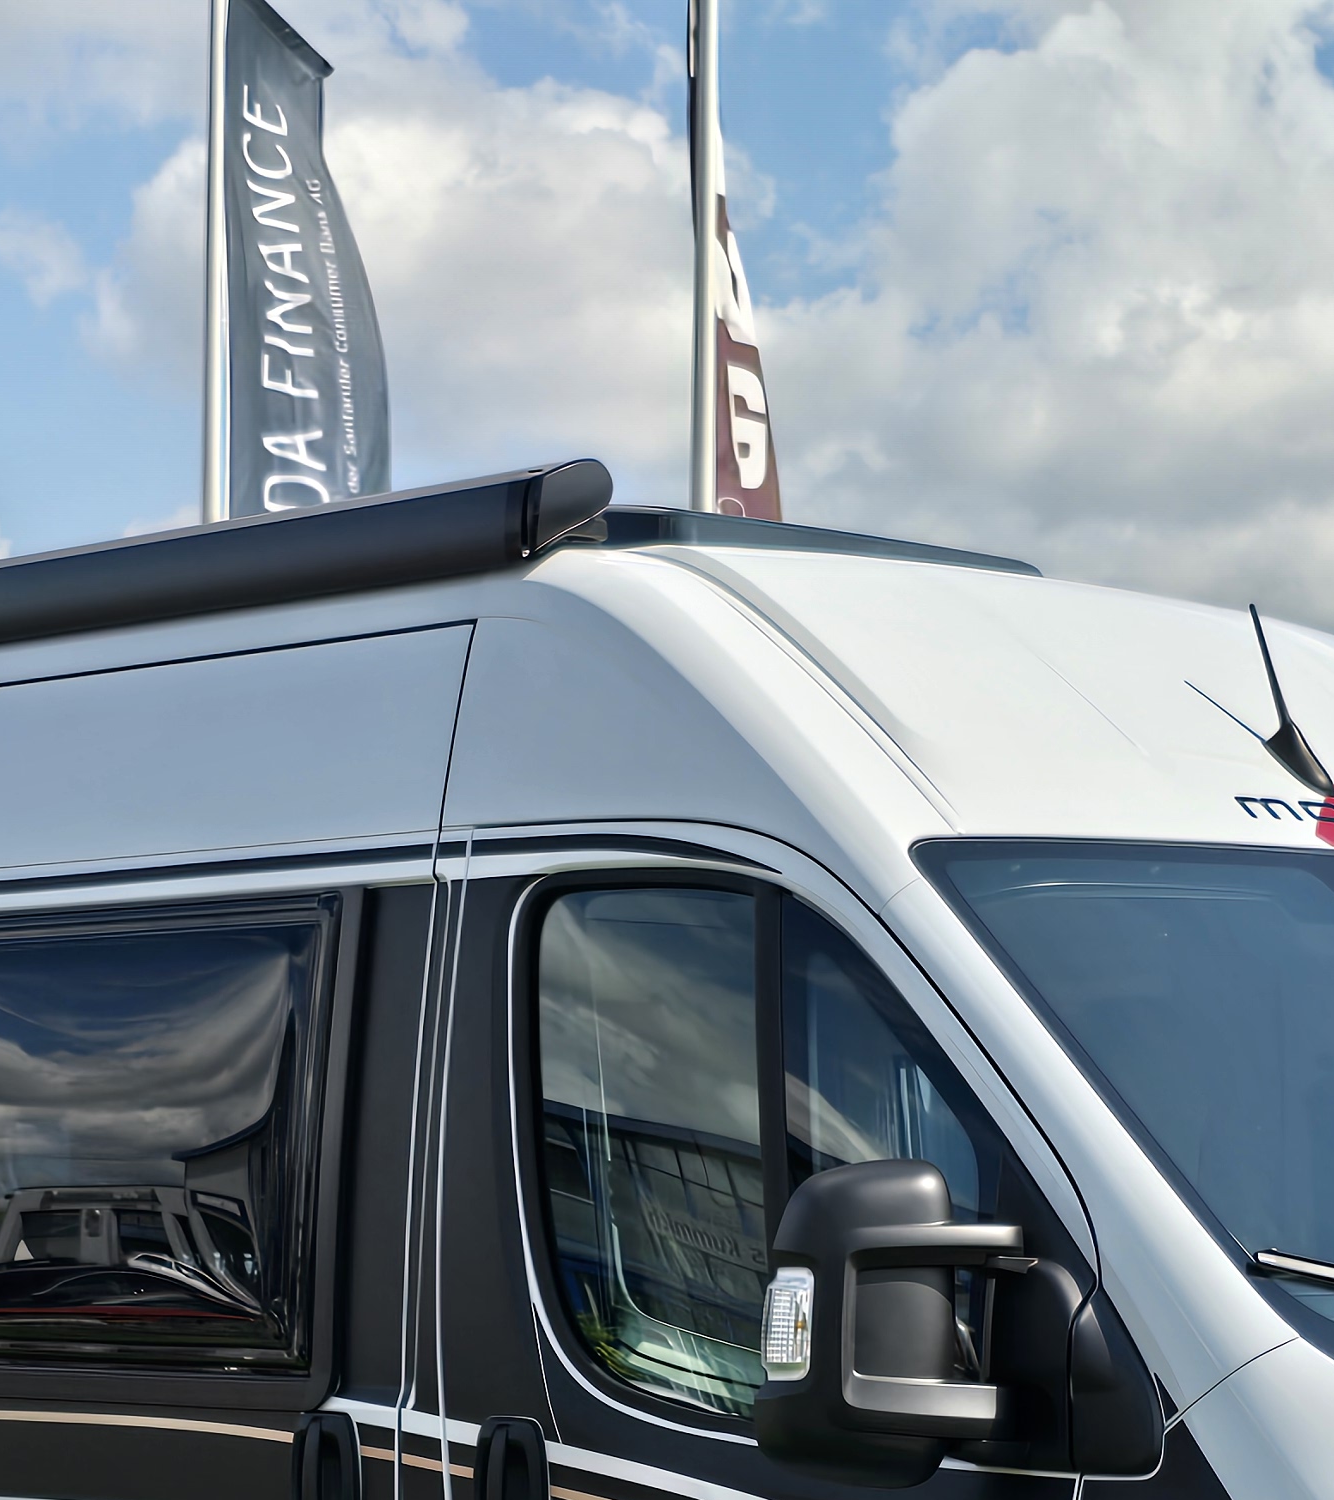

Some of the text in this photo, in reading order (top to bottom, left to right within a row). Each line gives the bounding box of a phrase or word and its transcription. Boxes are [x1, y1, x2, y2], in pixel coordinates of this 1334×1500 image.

[305, 179, 323, 206] AG
[242, 84, 319, 399] FINANCE
[327, 260, 348, 353] Consumer
[338, 358, 358, 457] Santander
[347, 462, 360, 494] der
